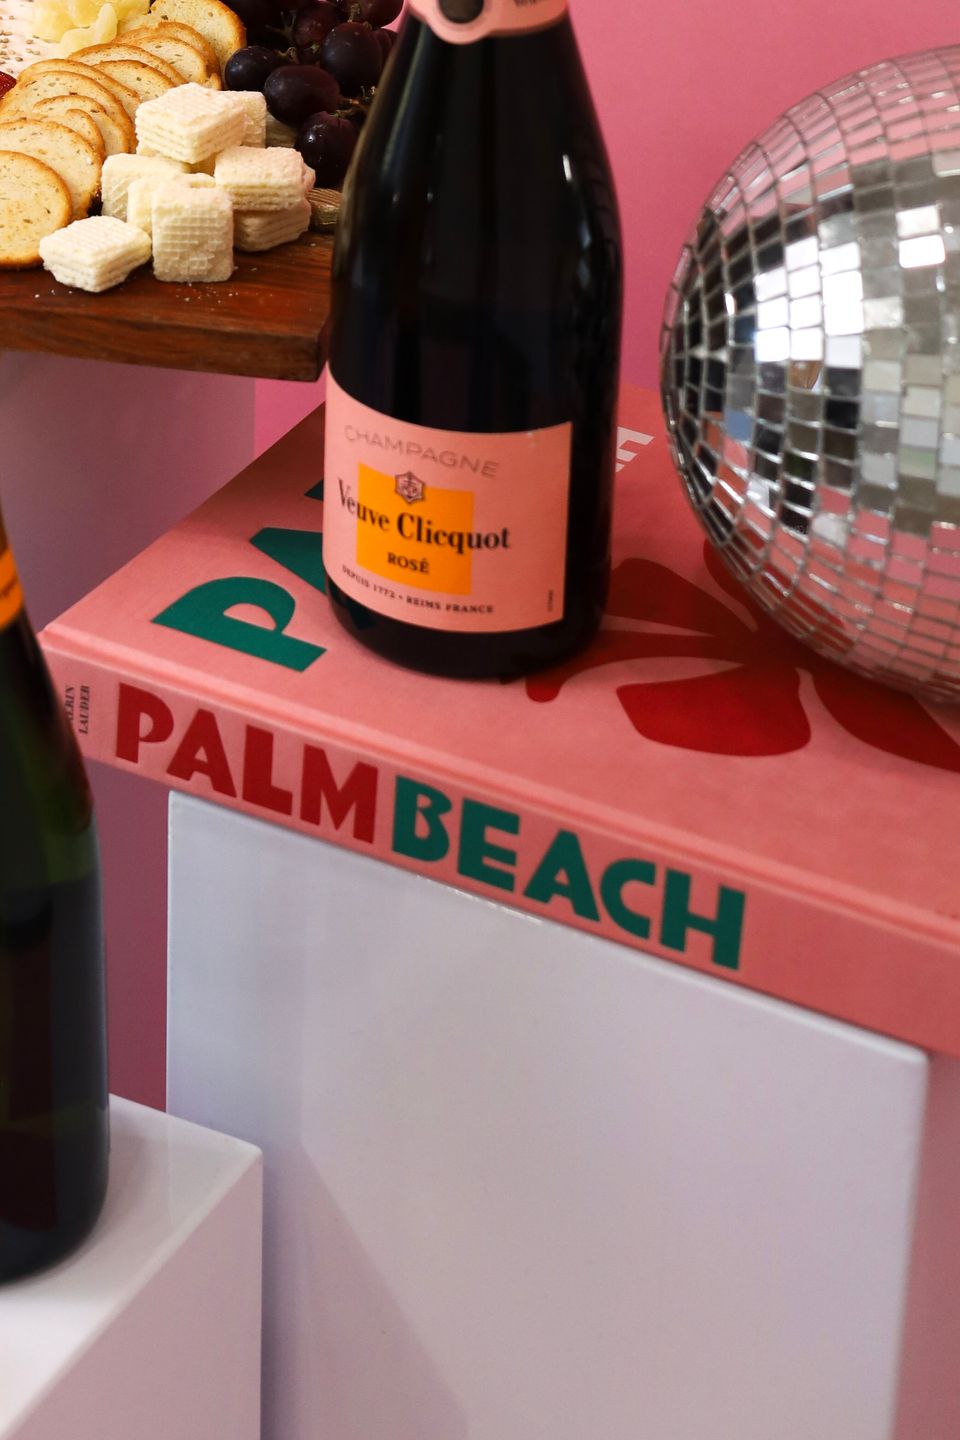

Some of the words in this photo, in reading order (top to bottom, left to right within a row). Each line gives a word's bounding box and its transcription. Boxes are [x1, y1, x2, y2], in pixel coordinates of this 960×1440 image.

[343, 424, 501, 478] CHAMPAGNE
[337, 477, 391, 532] Veuve
[396, 511, 510, 555] Clicquot
[341, 564, 371, 588] DEPUIS
[405, 595, 442, 611] REIMS
[444, 602, 495, 614] FRANCE
[386, 551, 431, 575] ROSÉ
[79, 685, 90, 736] LAUDER
[115, 682, 379, 844] PALM
[391, 775, 746, 971] BEACH
